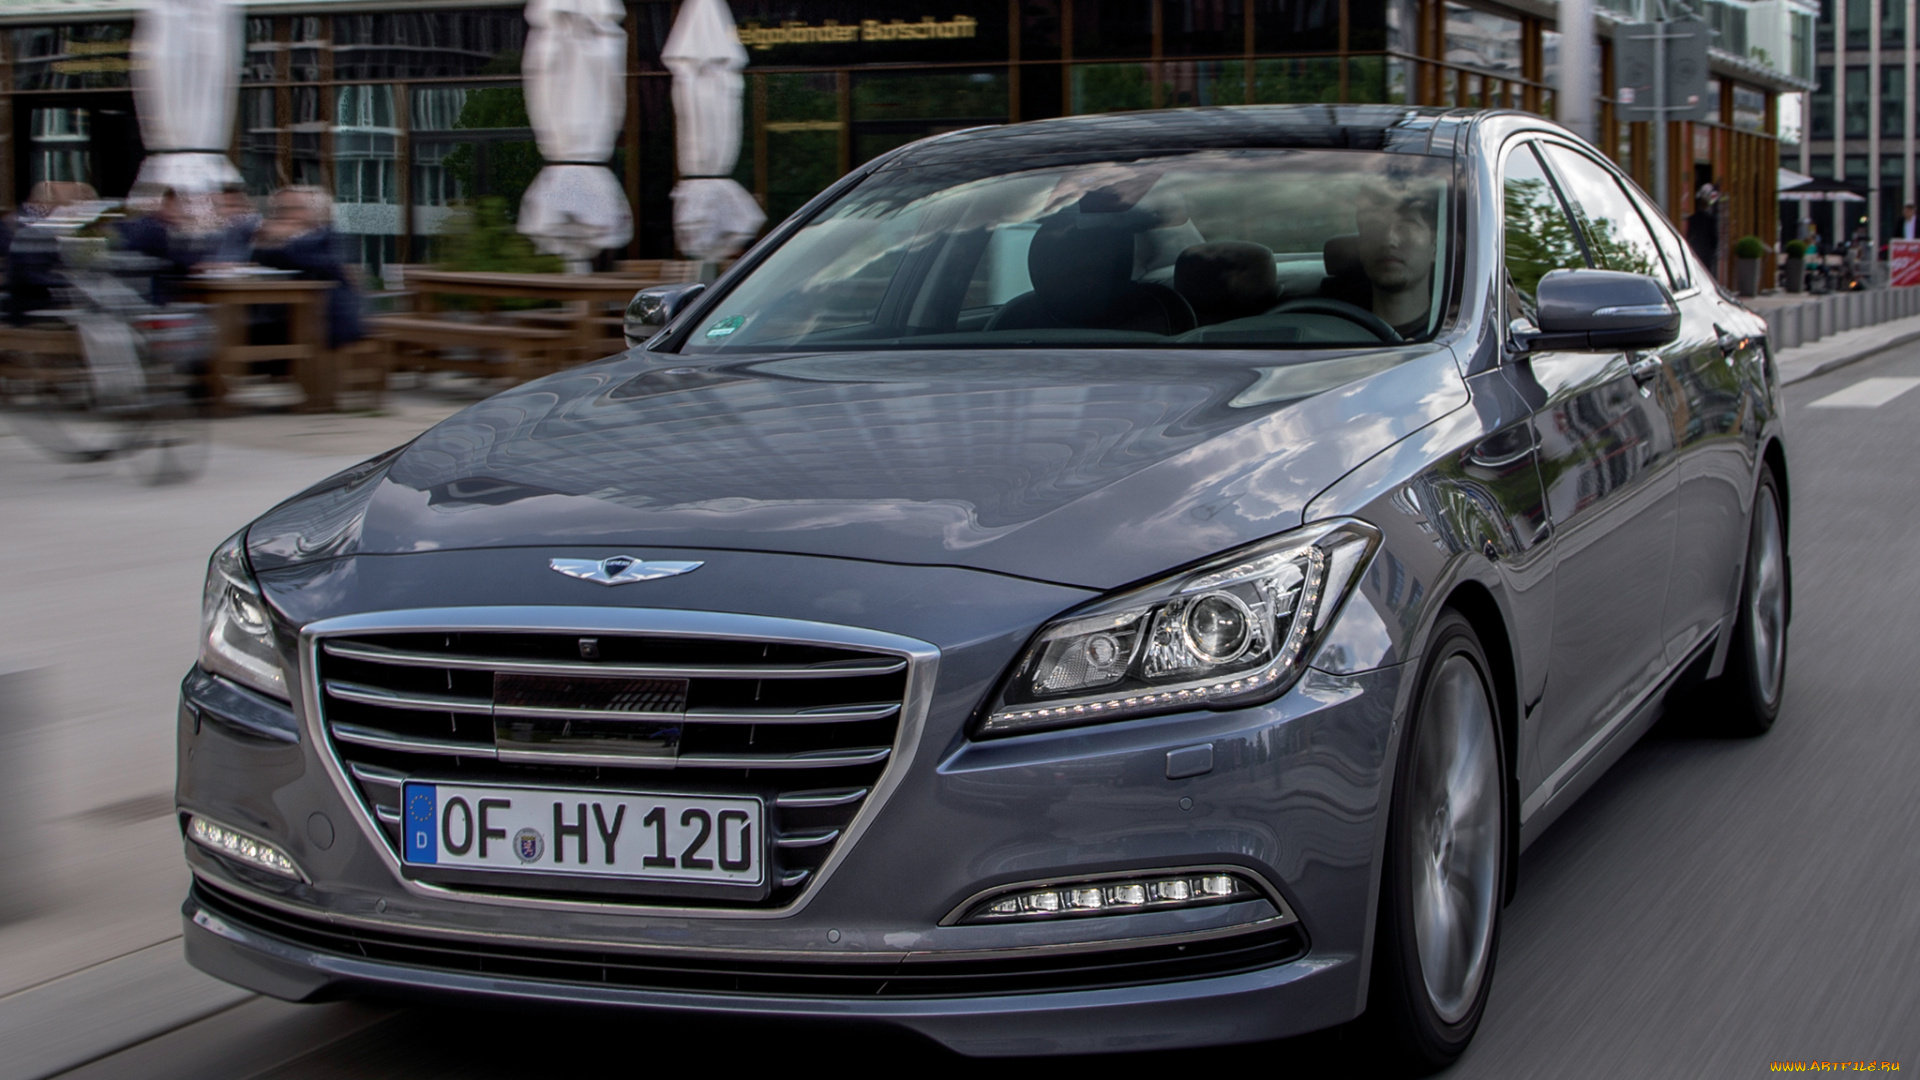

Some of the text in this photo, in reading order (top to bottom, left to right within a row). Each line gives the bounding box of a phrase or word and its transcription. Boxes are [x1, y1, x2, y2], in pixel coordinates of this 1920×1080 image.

[736, 15, 978, 50] elgoländer Botschaft
[416, 831, 428, 850] D
[441, 795, 512, 859] OF
[553, 801, 627, 865] HY
[642, 805, 752, 872] 120
